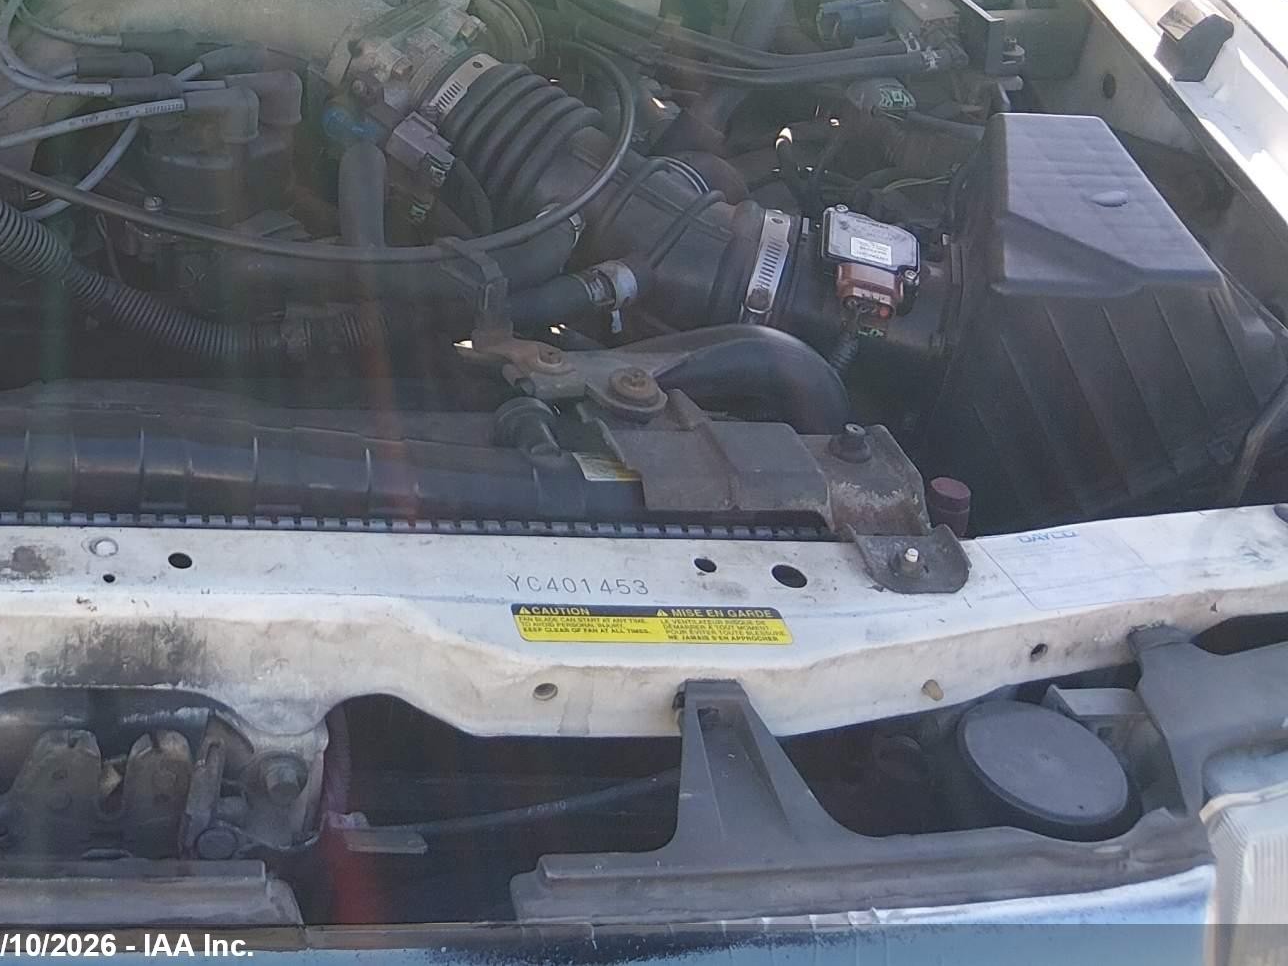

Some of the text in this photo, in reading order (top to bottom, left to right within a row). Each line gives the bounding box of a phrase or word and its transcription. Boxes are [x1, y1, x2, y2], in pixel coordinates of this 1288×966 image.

[506, 574, 649, 595] YC401453
[531, 606, 590, 616] CAUTION
[672, 608, 773, 618] MISE EN GARDE
